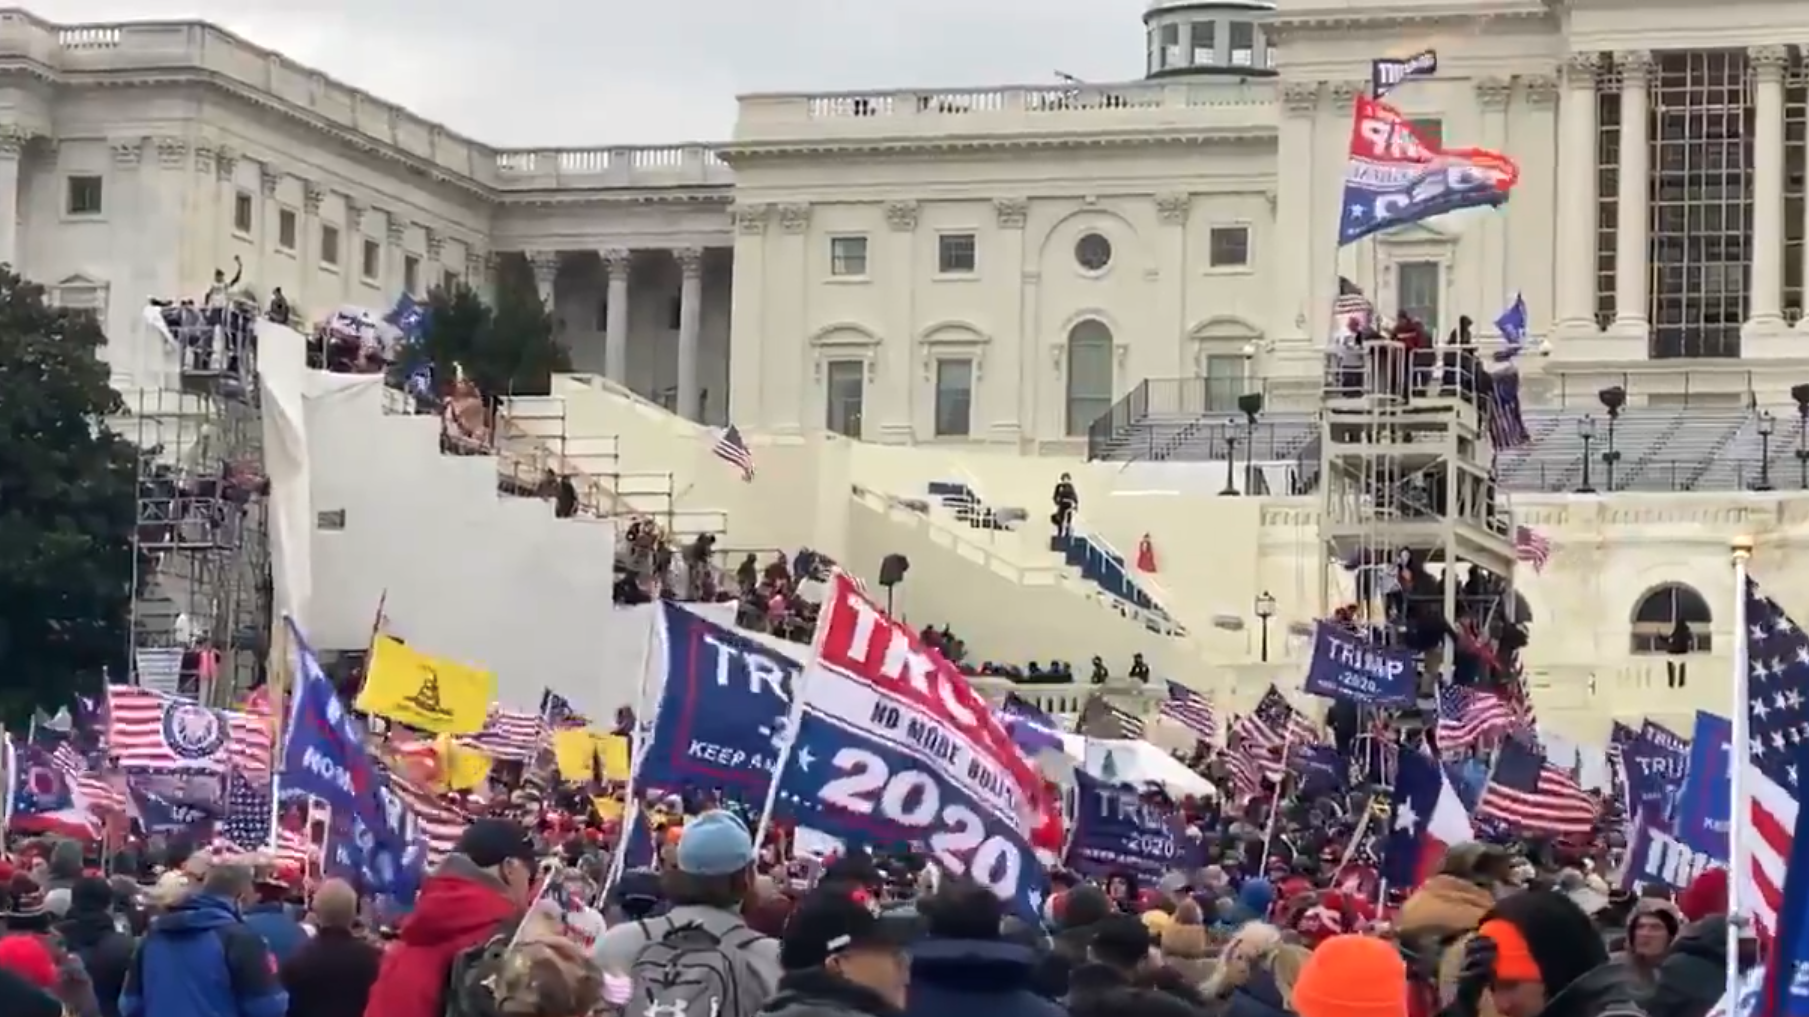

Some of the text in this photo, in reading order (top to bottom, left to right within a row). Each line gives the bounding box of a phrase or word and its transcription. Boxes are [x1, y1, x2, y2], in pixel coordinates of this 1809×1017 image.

[1327, 635, 1405, 682] TRUMP
[688, 739, 747, 768] KEEP
[870, 701, 900, 730] NO
[907, 717, 963, 766] MORE
[817, 747, 1022, 899] 2020
